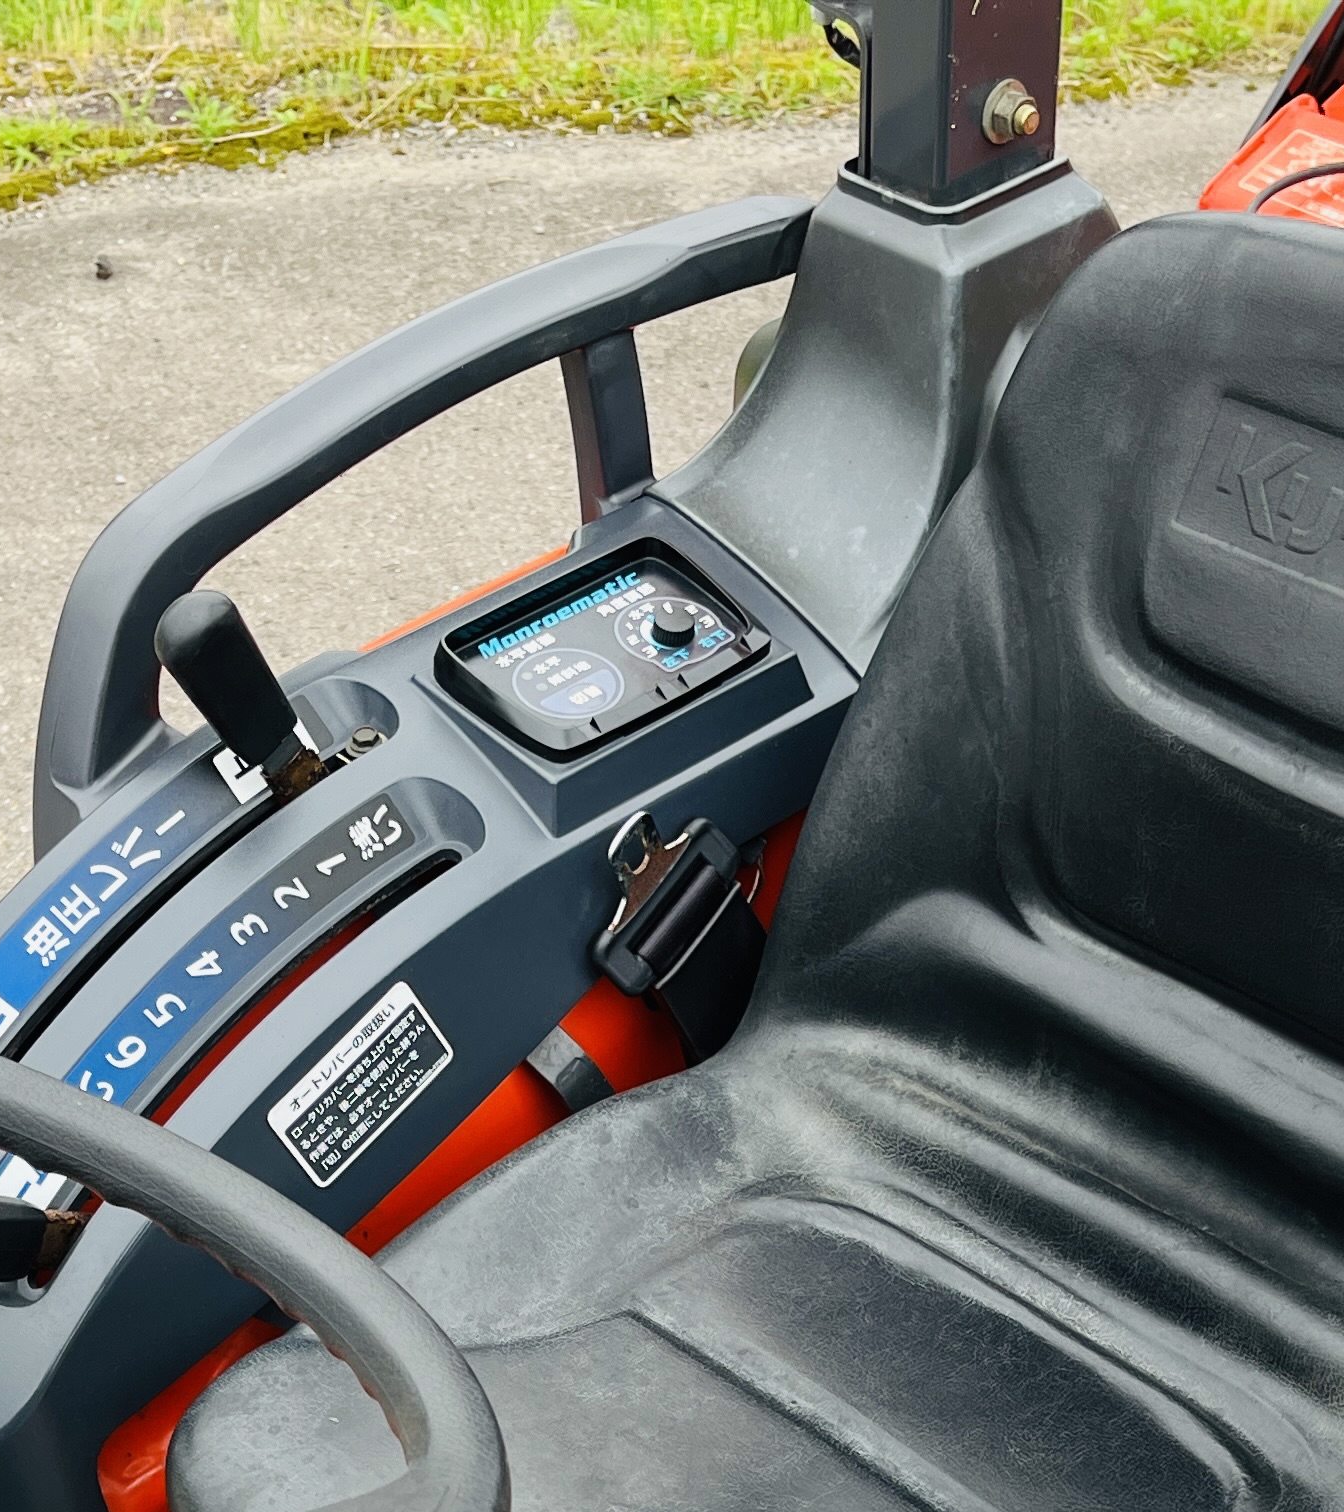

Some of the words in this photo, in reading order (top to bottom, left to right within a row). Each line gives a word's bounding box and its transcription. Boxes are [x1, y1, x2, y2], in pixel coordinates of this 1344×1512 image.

[478, 570, 640, 660] Monroematic
[626, 633, 641, 646] 2
[698, 615, 715, 630] 3
[532, 656, 561, 676] 水平
[642, 645, 658, 659] 3
[23, 810, 186, 968] 油圧レバー
[105, 1035, 147, 1071] 6
[143, 993, 187, 1029] 5
[185, 949, 223, 980] 4
[230, 912, 269, 947] 3
[273, 877, 311, 910] 2
[315, 853, 347, 877] 1
[286, 1001, 397, 1112] オートレバーの取扱い
